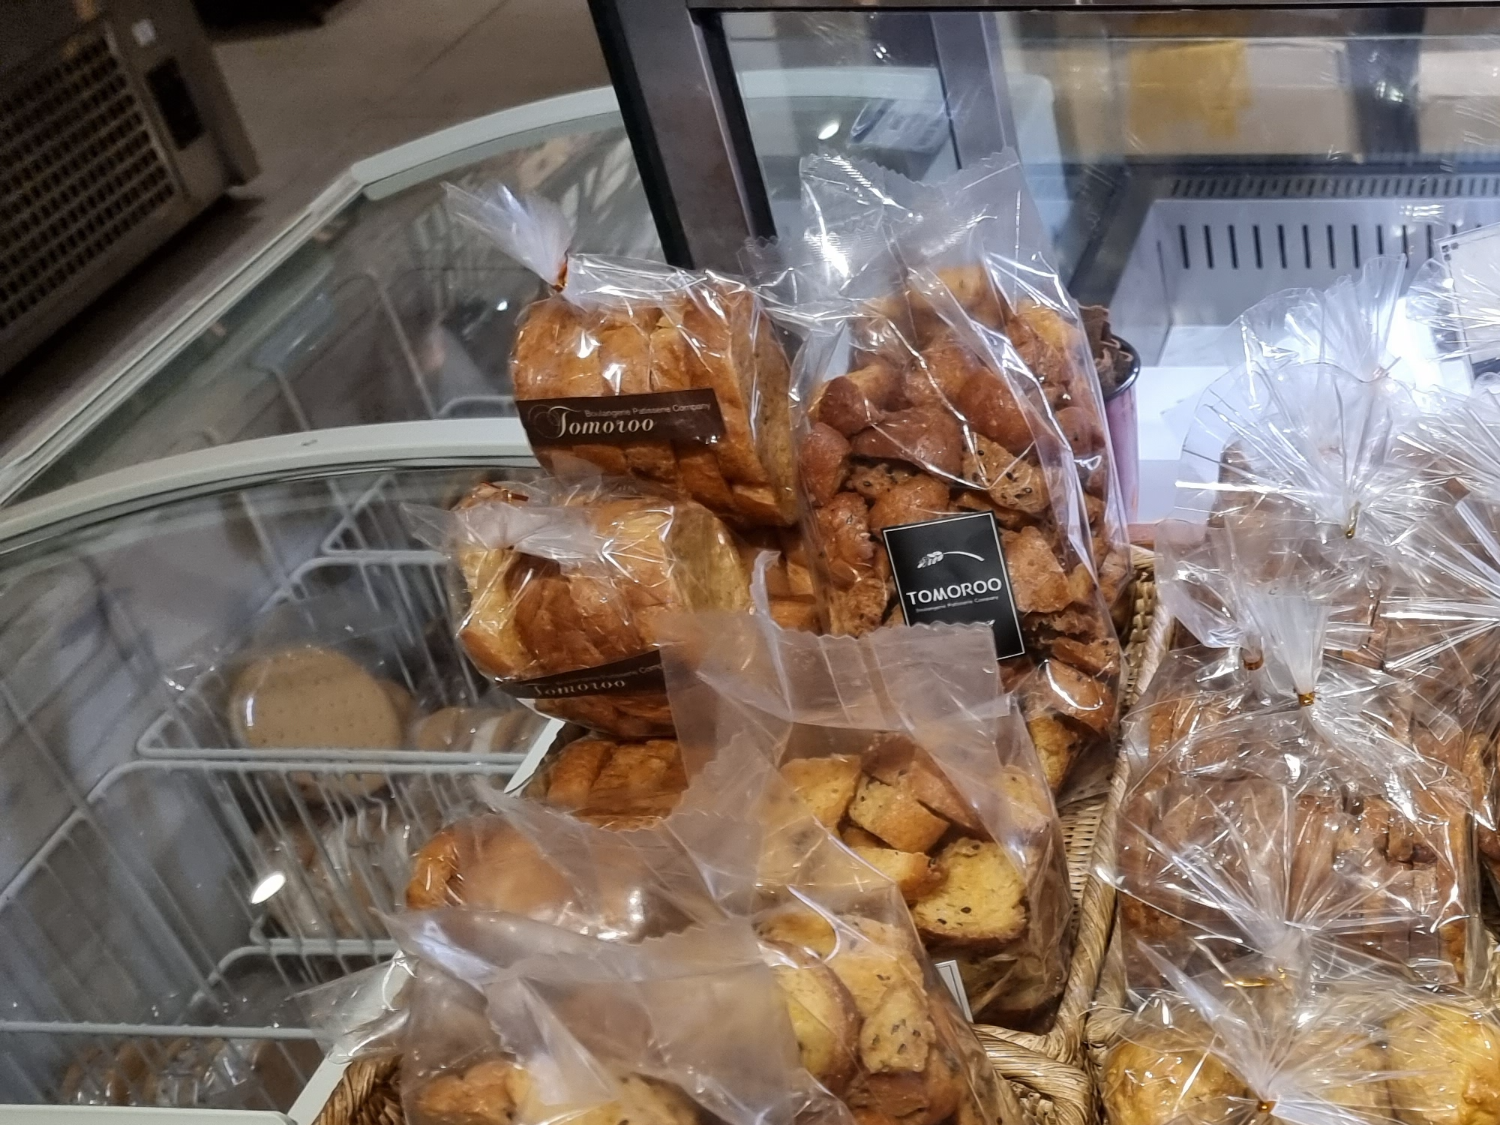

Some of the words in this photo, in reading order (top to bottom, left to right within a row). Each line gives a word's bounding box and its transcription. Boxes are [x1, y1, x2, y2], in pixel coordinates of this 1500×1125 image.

[672, 402, 711, 414] Company
[532, 404, 656, 439] Tomoroo
[906, 577, 1002, 605] TOMOROO
[533, 678, 627, 698] Tomoroo
